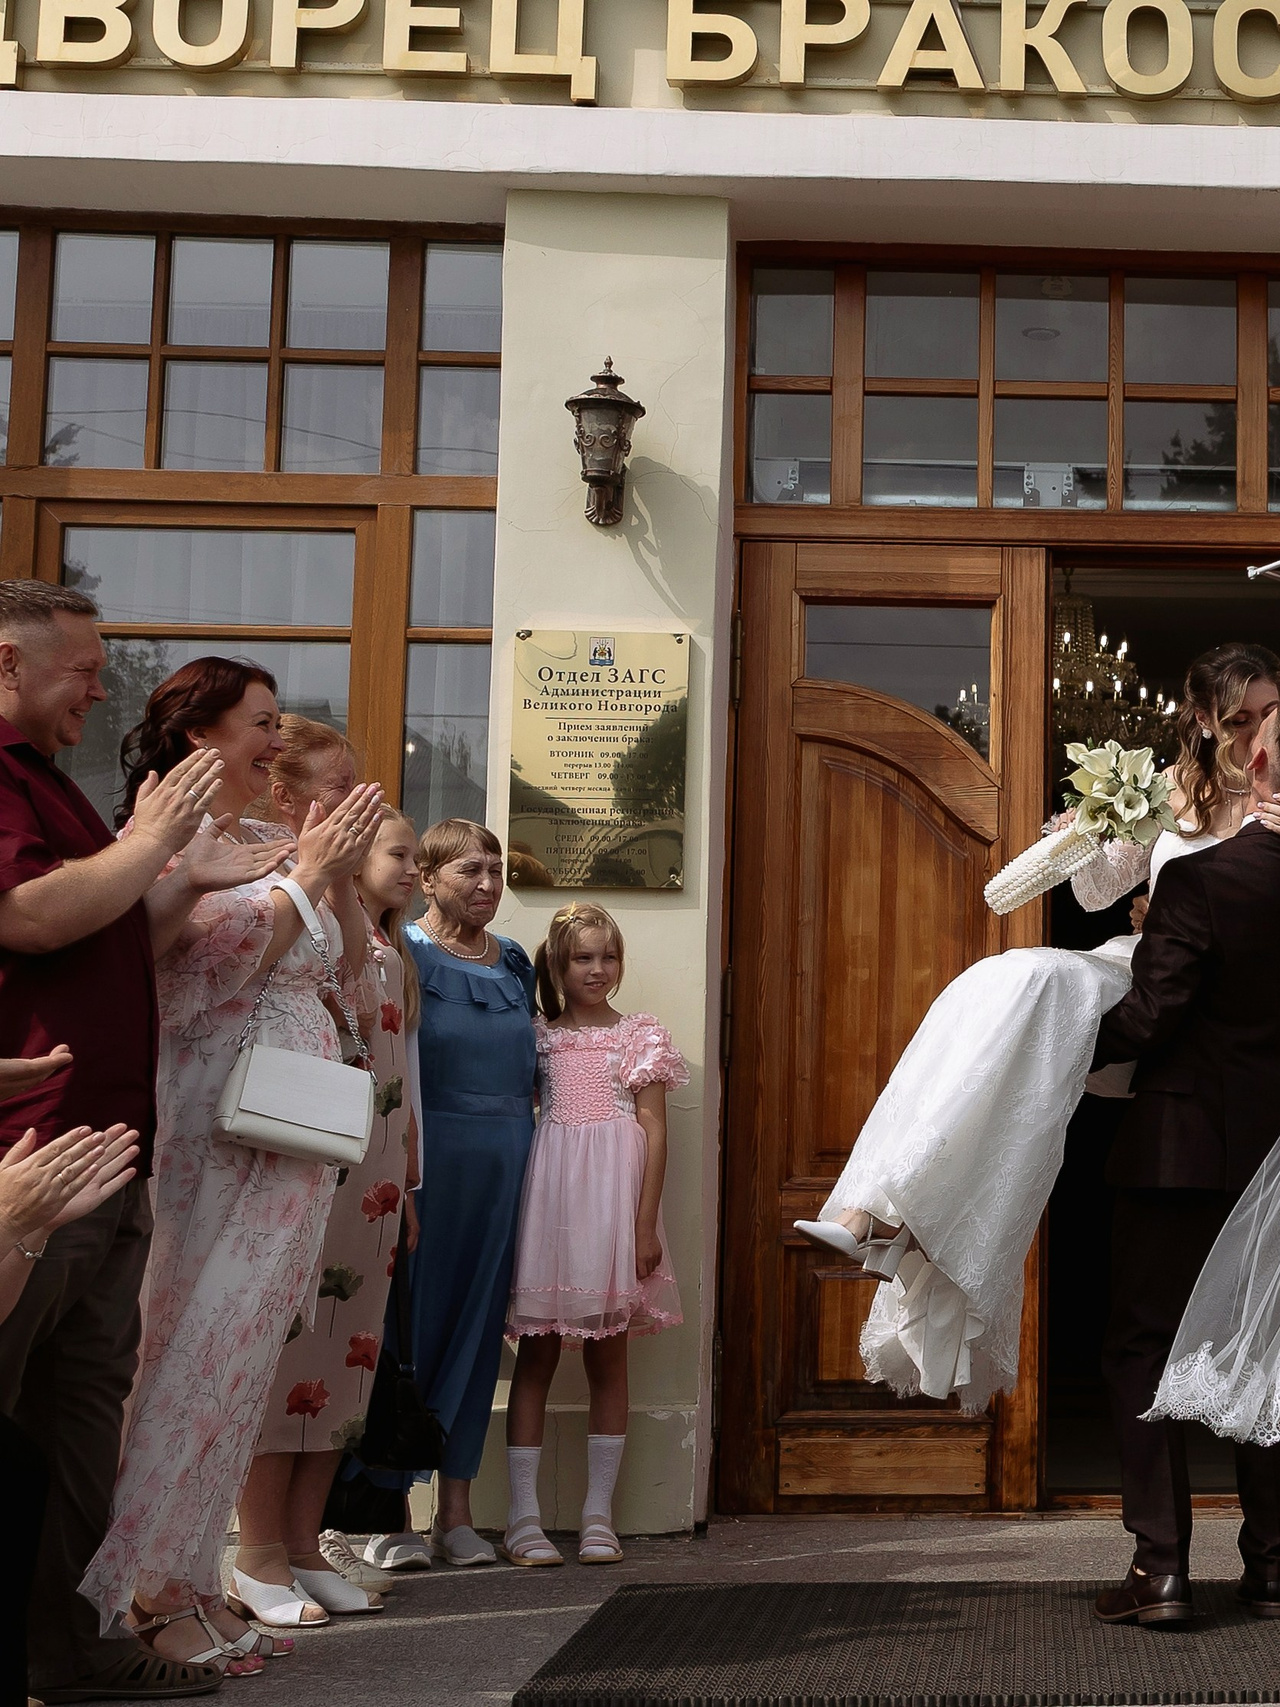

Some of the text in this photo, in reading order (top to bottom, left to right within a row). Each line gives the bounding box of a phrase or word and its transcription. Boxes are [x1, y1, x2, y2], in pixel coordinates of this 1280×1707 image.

[0, 0, 596, 103] ВОРЕЦ
[537, 666, 666, 685] Отдел ЗАГС
[539, 685, 662, 700] Администрации
[522, 699, 678, 715] Великого Новгорода
[558, 722, 649, 734] Прием заявлений
[556, 734, 619, 743] заключении
[621, 734, 654, 745] брака:
[550, 750, 595, 759] ВТОРНИК
[600, 751, 621, 759] 09.00
[550, 772, 591, 780] ЧЕТВЕРГ
[520, 805, 607, 816] Государственная
[548, 818, 646, 828] заключения брака:
[554, 835, 584, 843] СРЕДА
[545, 847, 592, 855] ПЯТНИЦА
[627, 848, 647, 856] 17.00
[545, 866, 588, 876] СУББОТА
